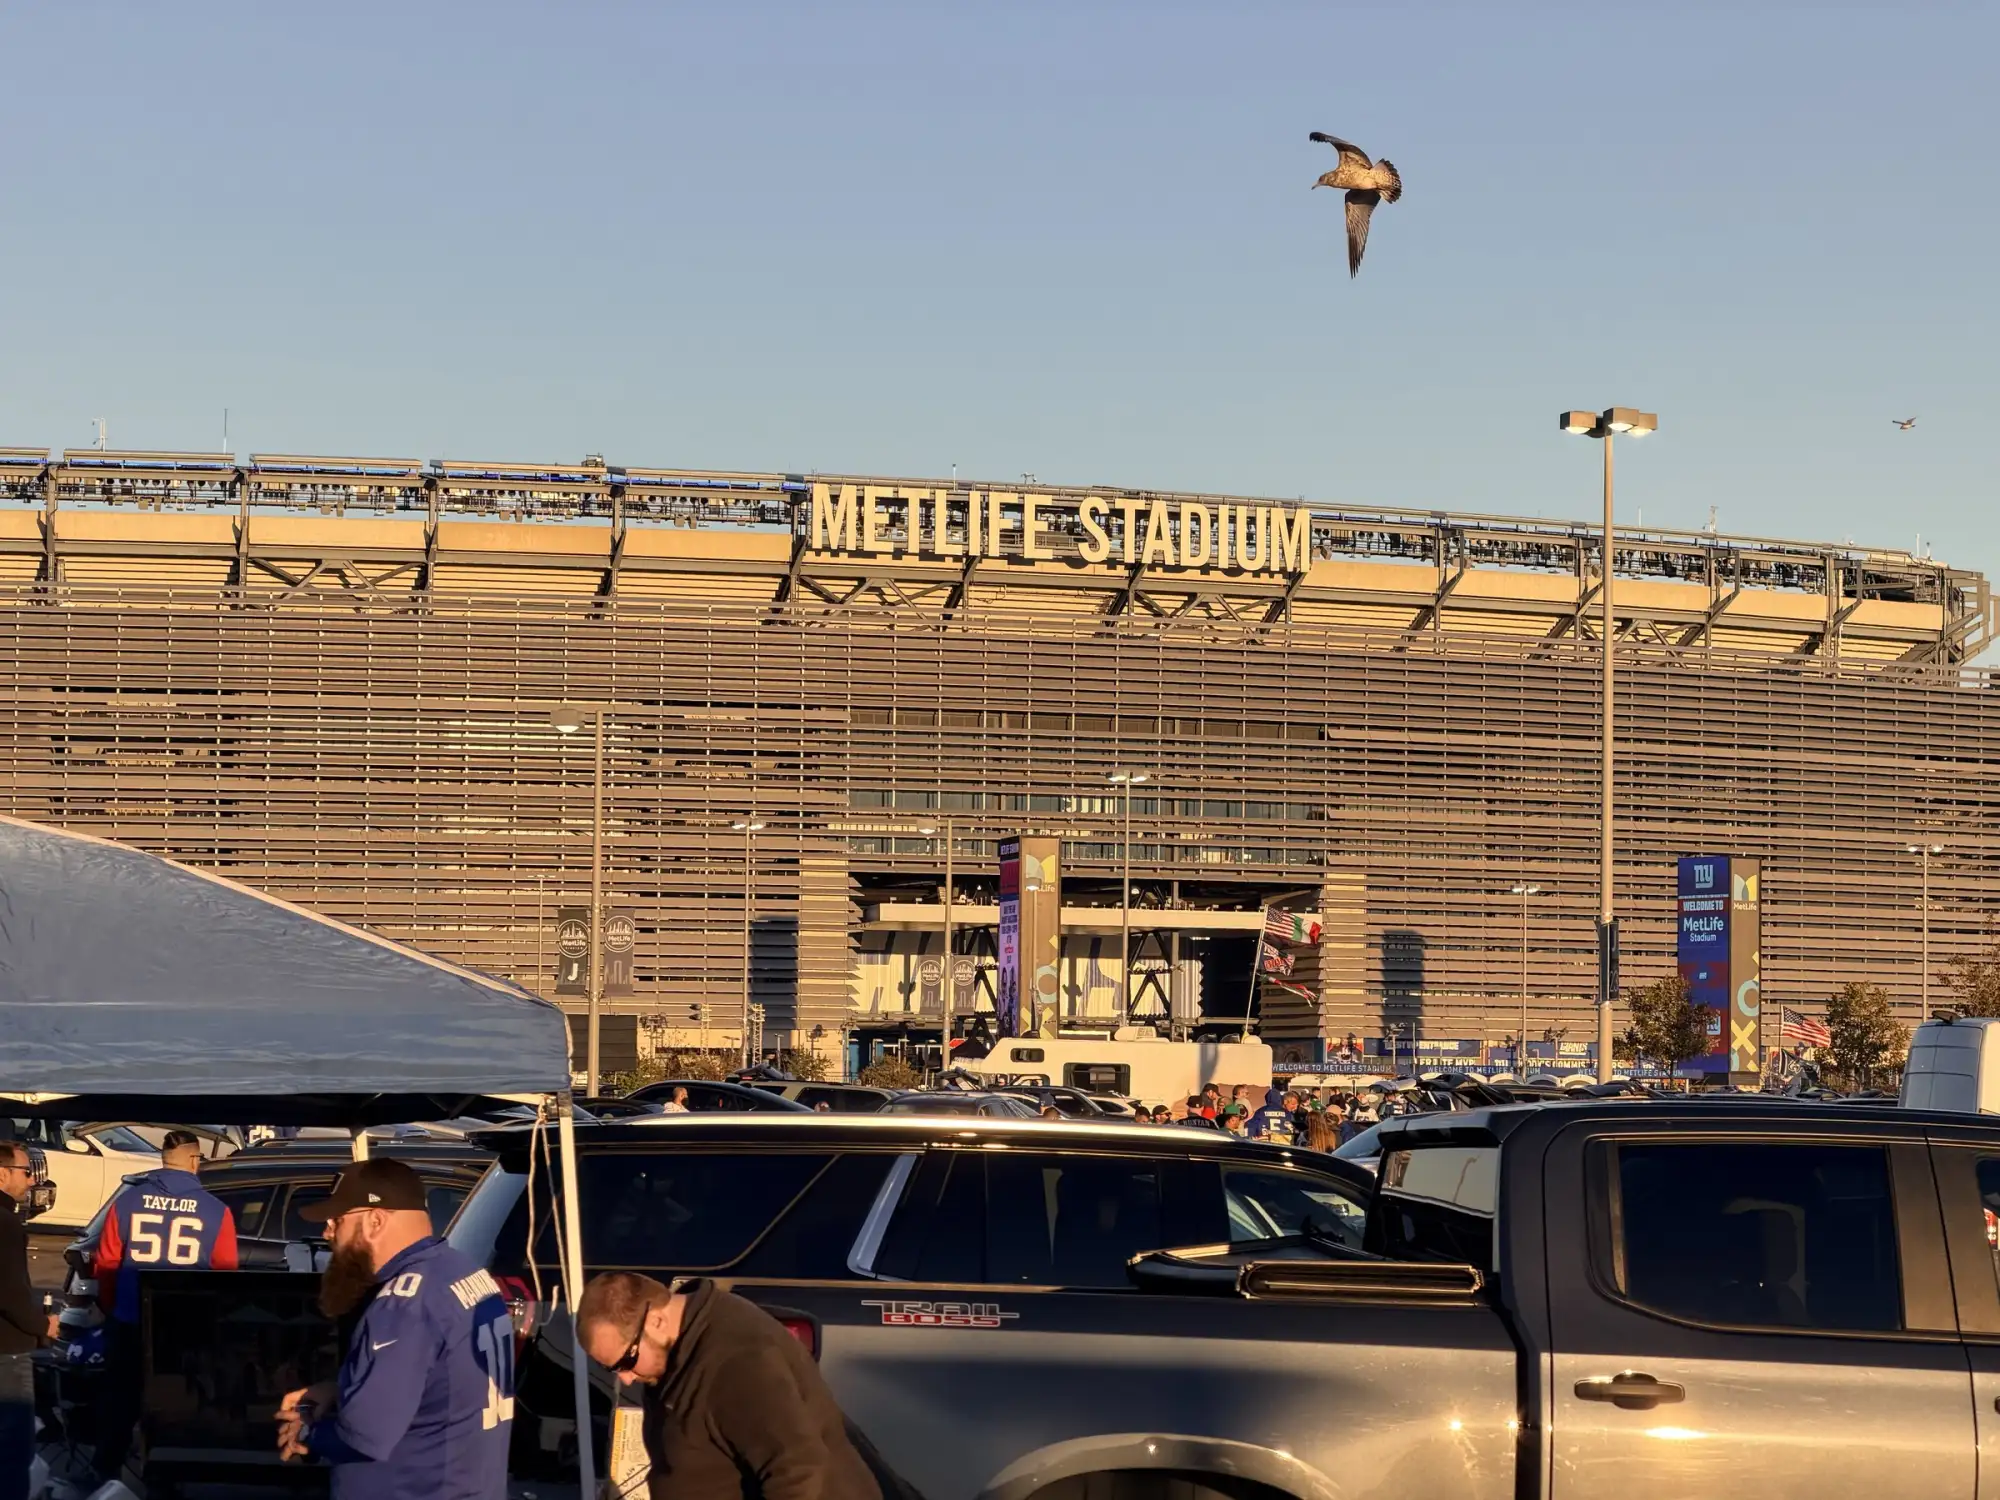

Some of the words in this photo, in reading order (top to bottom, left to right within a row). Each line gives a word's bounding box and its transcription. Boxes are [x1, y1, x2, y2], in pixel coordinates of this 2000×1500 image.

[811, 483, 1054, 560] METLIFE
[1077, 496, 1311, 574] STADIUM
[1682, 900, 1715, 912] WELCOME
[1715, 900, 1724, 911] TO
[1734, 902, 1758, 911] MetLife
[1683, 916, 1724, 932] MetLife
[1689, 932, 1717, 943] Stadium
[1272, 1063, 1309, 1072] WELCOME
[1312, 1063, 1321, 1072] TO
[1323, 1063, 1356, 1073] METLIFE
[1357, 1064, 1392, 1073] STADIUM
[1476, 1066, 1508, 1074] METLIFE
[1624, 1069, 1652, 1077] METLIFE
[142, 1194, 198, 1213] TAYLOR
[130, 1213, 204, 1266] 56
[861, 1299, 1020, 1318] TRAIL
[882, 1312, 1001, 1328] BOSS
